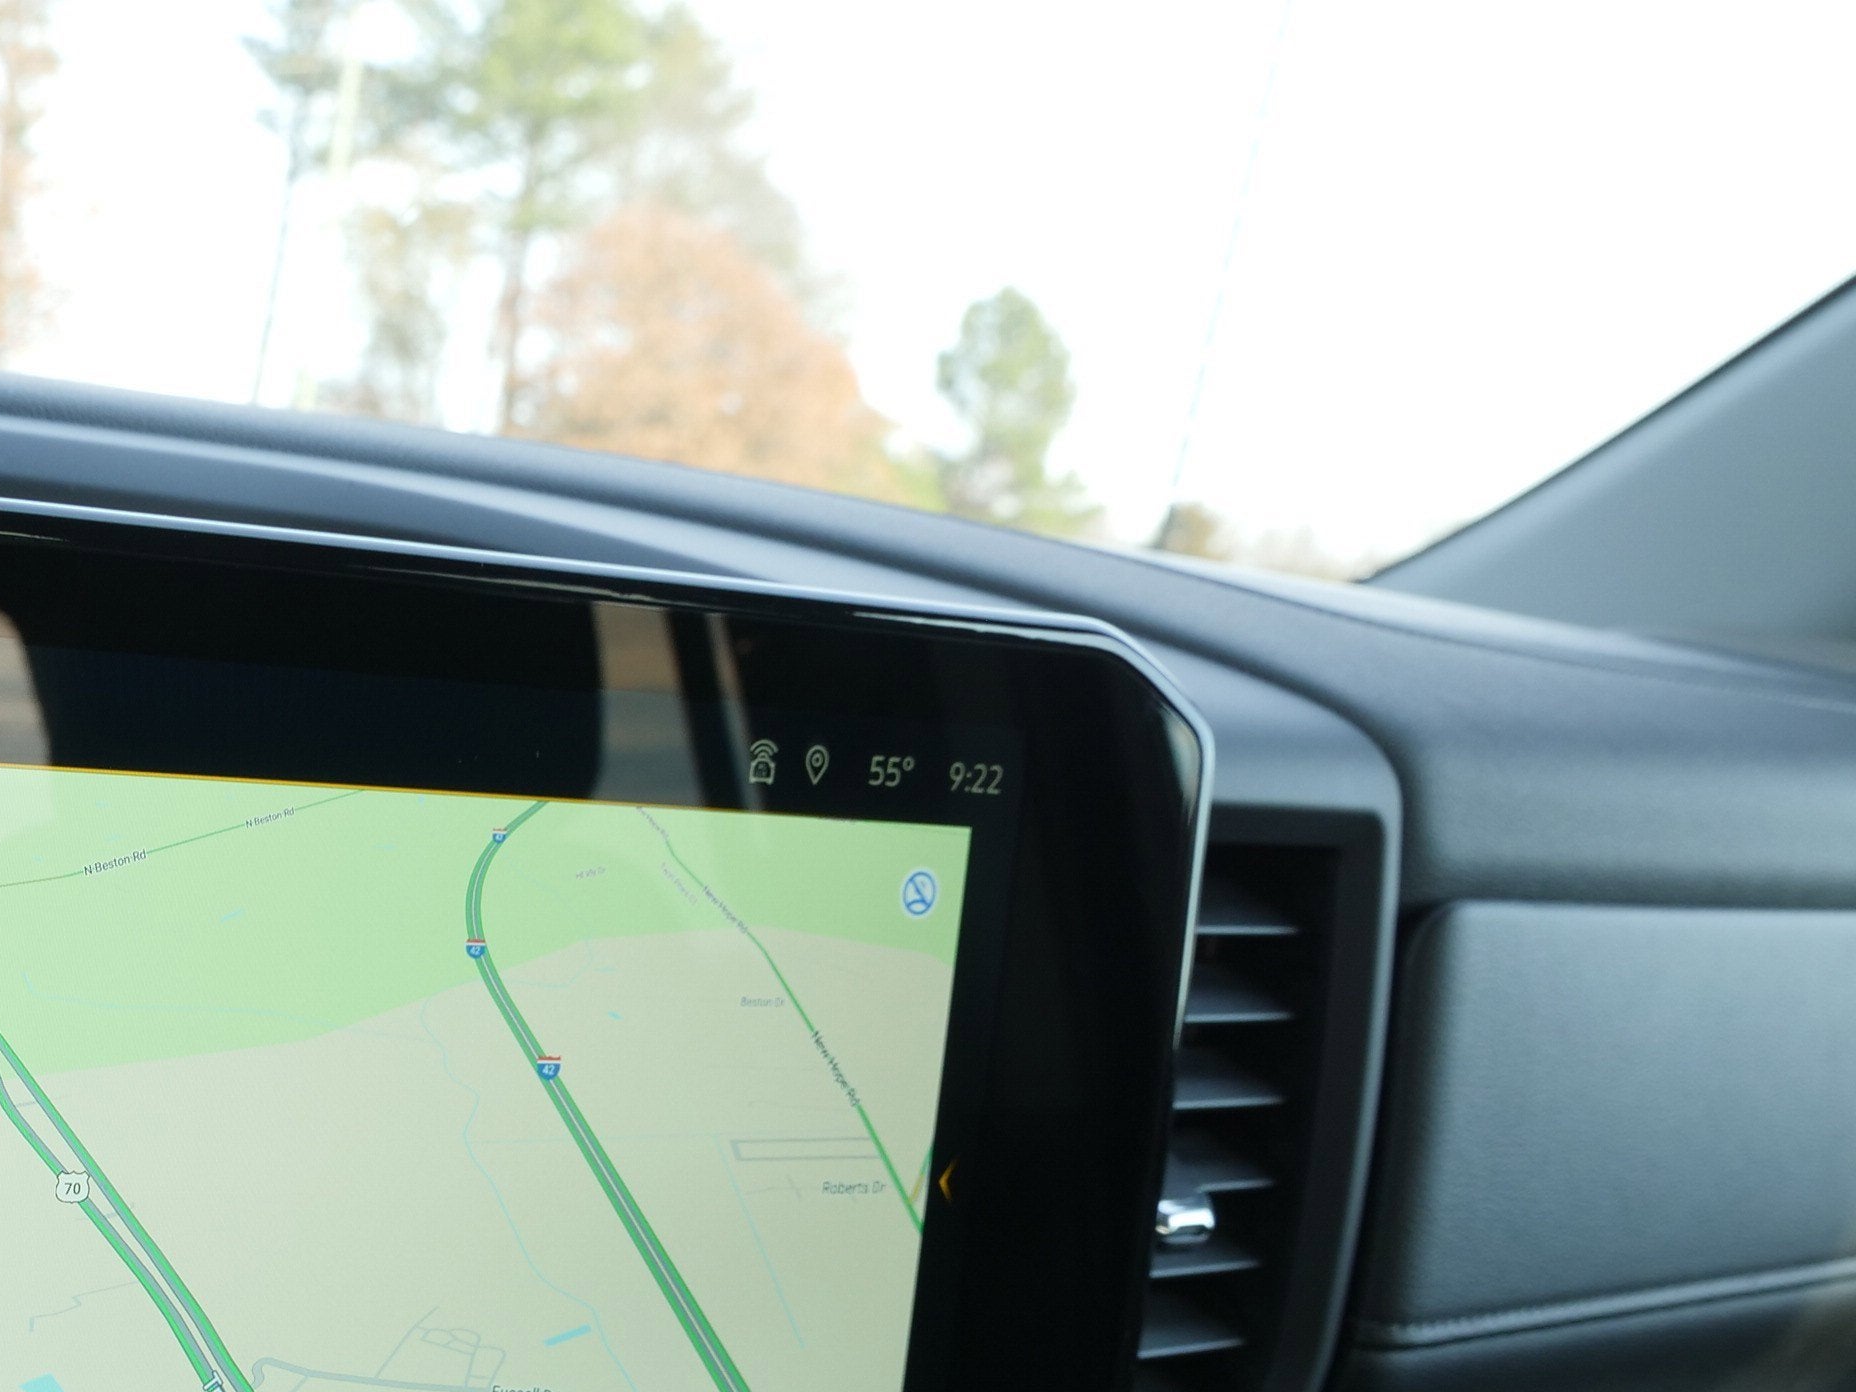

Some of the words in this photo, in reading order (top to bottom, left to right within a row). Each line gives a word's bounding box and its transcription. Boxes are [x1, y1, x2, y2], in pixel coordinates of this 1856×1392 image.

[949, 761, 1004, 795] 9:22
[245, 819, 253, 829] N
[254, 812, 282, 827] Beston
[284, 806, 295, 818] Rd
[84, 865, 93, 876] N
[95, 855, 131, 874] Beston
[132, 848, 147, 862] Rd
[63, 1181, 82, 1196] 70
